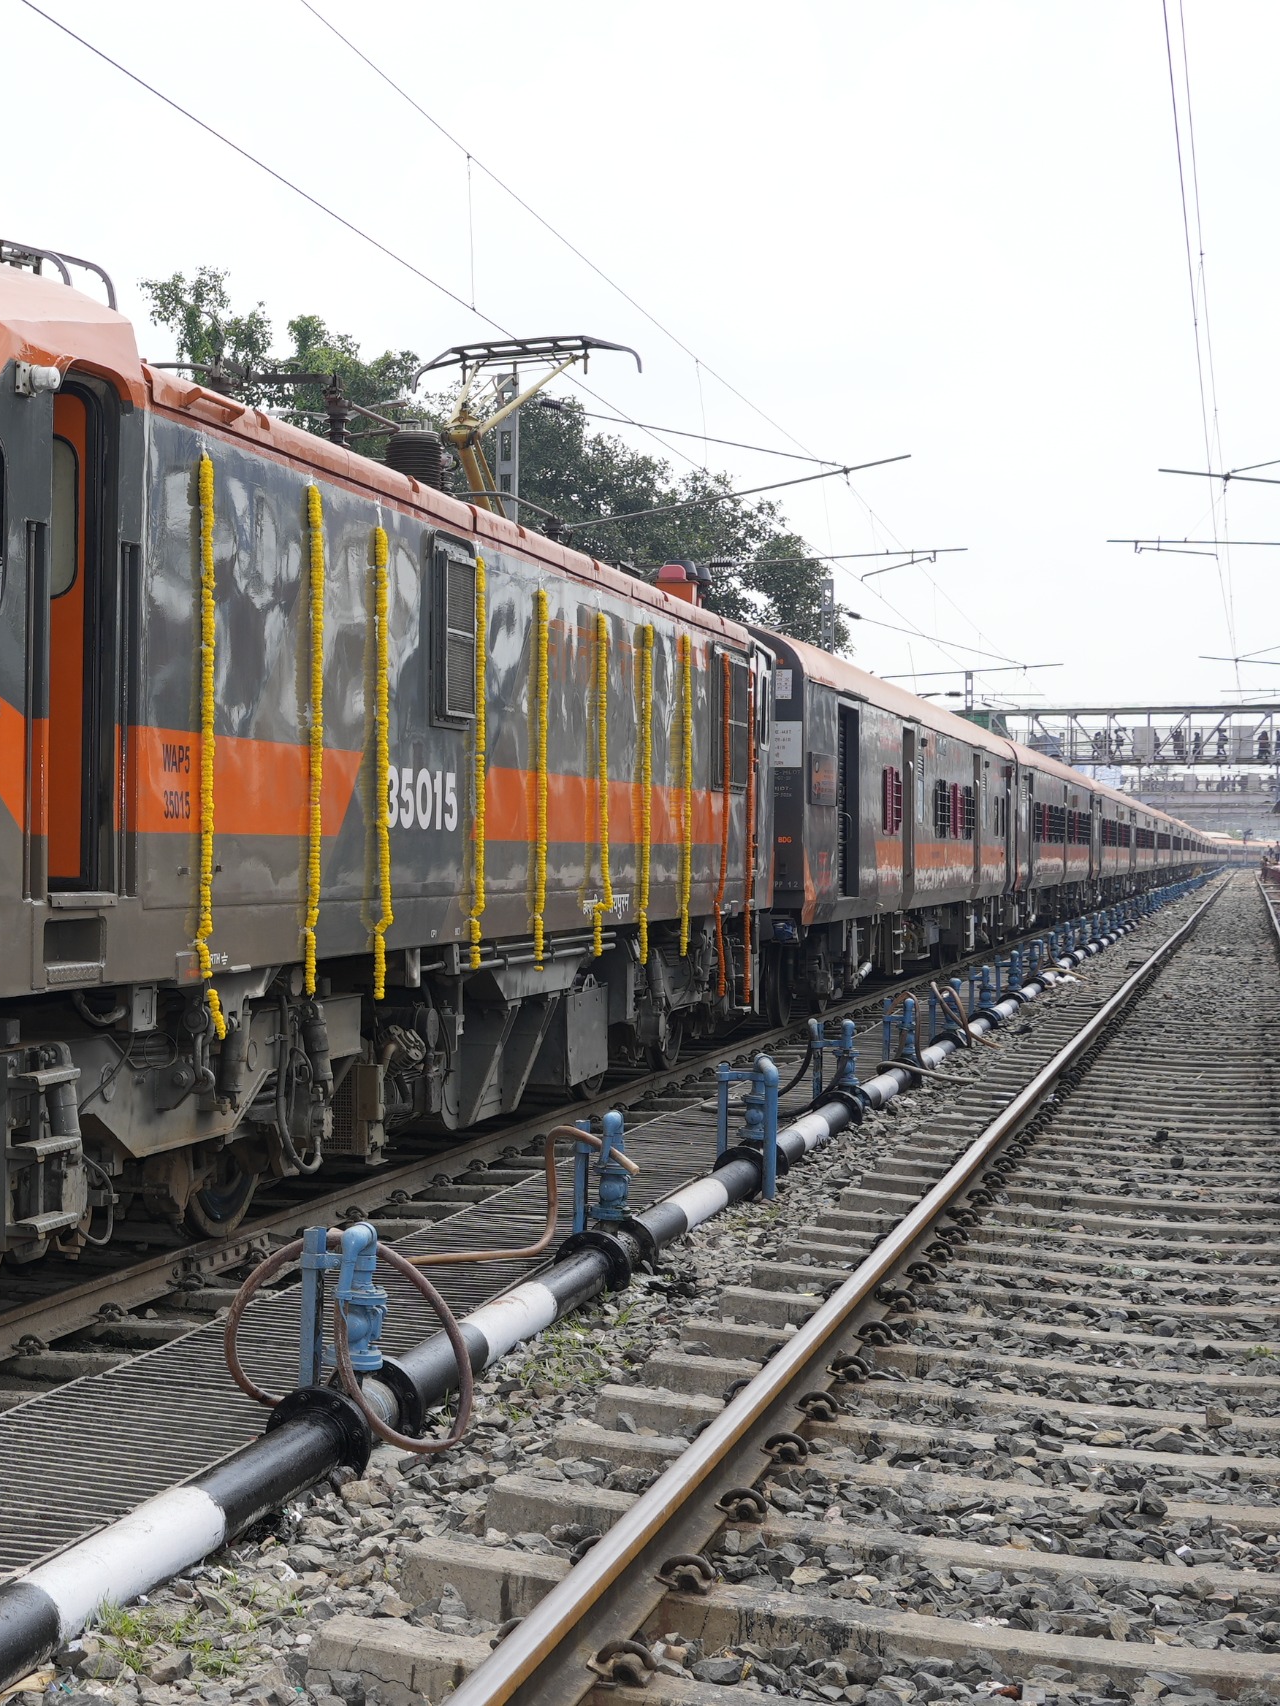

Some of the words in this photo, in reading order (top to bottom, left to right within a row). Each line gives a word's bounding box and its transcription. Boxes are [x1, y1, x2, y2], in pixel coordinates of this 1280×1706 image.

[162, 744, 190, 774] WAP5
[163, 790, 191, 819] 35015
[387, 765, 458, 832] 35015
